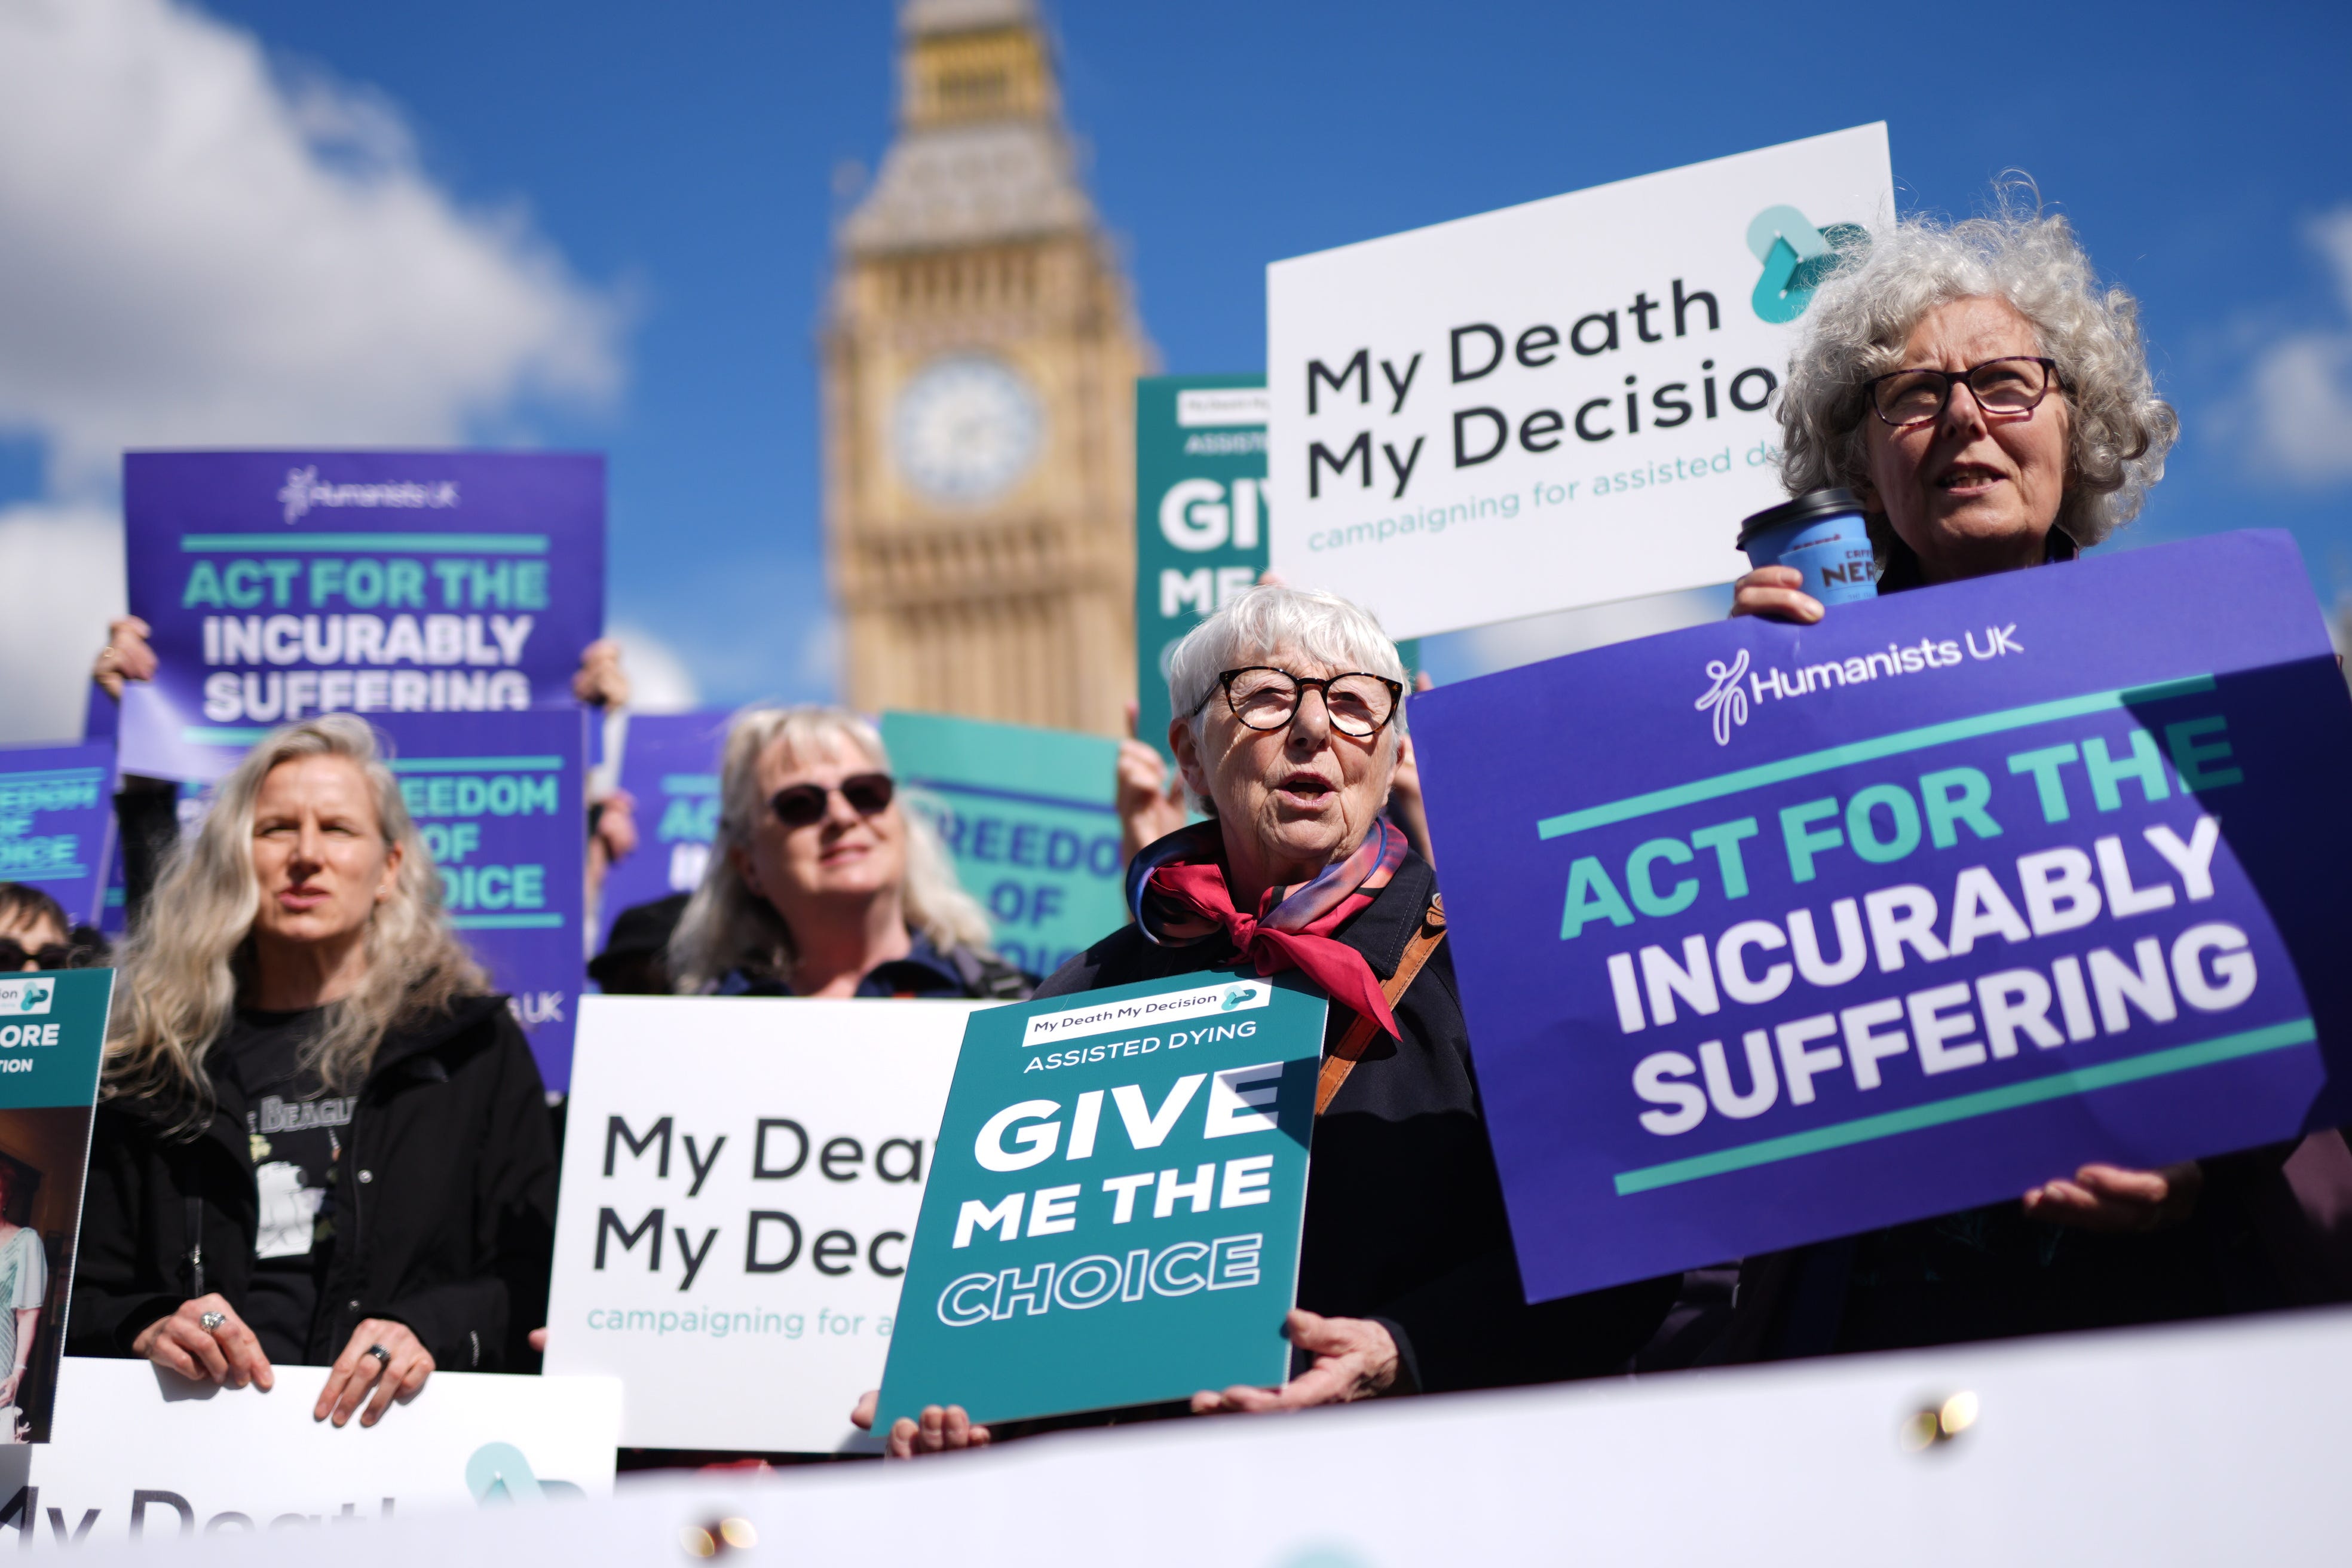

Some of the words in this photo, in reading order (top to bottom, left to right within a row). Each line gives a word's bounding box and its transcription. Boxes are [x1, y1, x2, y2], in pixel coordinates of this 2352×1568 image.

[1307, 348, 1423, 416] My
[1448, 278, 1720, 385] Death
[1307, 431, 1426, 500] My
[1453, 360, 1780, 469] Decisio
[1158, 478, 1269, 552] GI
[1307, 490, 1521, 552] campaigning
[1533, 480, 1576, 509] for
[1592, 446, 1732, 498] assisted
[182, 559, 301, 610] ACT
[310, 558, 427, 609] FOR
[433, 558, 550, 610] THE
[1821, 561, 1875, 587] NER
[203, 613, 534, 666] INCURABLY
[1750, 637, 1963, 705] Humanists
[1965, 622, 2025, 660] UK
[203, 670, 531, 722] SUFFERING
[399, 774, 561, 817] EEDOM
[657, 797, 721, 844] AC
[420, 822, 480, 864] OF
[937, 809, 1123, 878] REEDO
[1559, 816, 1759, 941] ACT
[1779, 766, 2003, 883] FOR
[2007, 715, 2244, 825] THE
[439, 863, 545, 910] OICE
[989, 878, 1064, 929] OF
[1606, 814, 2221, 1034] INCURABLY
[0, 1023, 60, 1048] ORE
[523, 991, 565, 1024] UK
[1034, 1021, 1058, 1034] My
[1061, 1011, 1113, 1028] Death
[1117, 1006, 1141, 1019] My
[1145, 994, 1217, 1013] Decision
[1631, 922, 2259, 1137] SUFFERING
[1023, 1037, 1160, 1074] ASSISTED
[1168, 1021, 1257, 1049] DYING
[974, 1061, 1284, 1172] GIVE
[602, 1114, 729, 1198] My
[752, 1116, 925, 1184] Dea
[952, 1183, 1082, 1249] ME
[1102, 1154, 1274, 1224] THE
[593, 1206, 720, 1292] My
[745, 1209, 907, 1278] Dec
[936, 1232, 1263, 1327] CHOICE
[587, 1304, 806, 1340] campaigning
[817, 1307, 866, 1336] for
